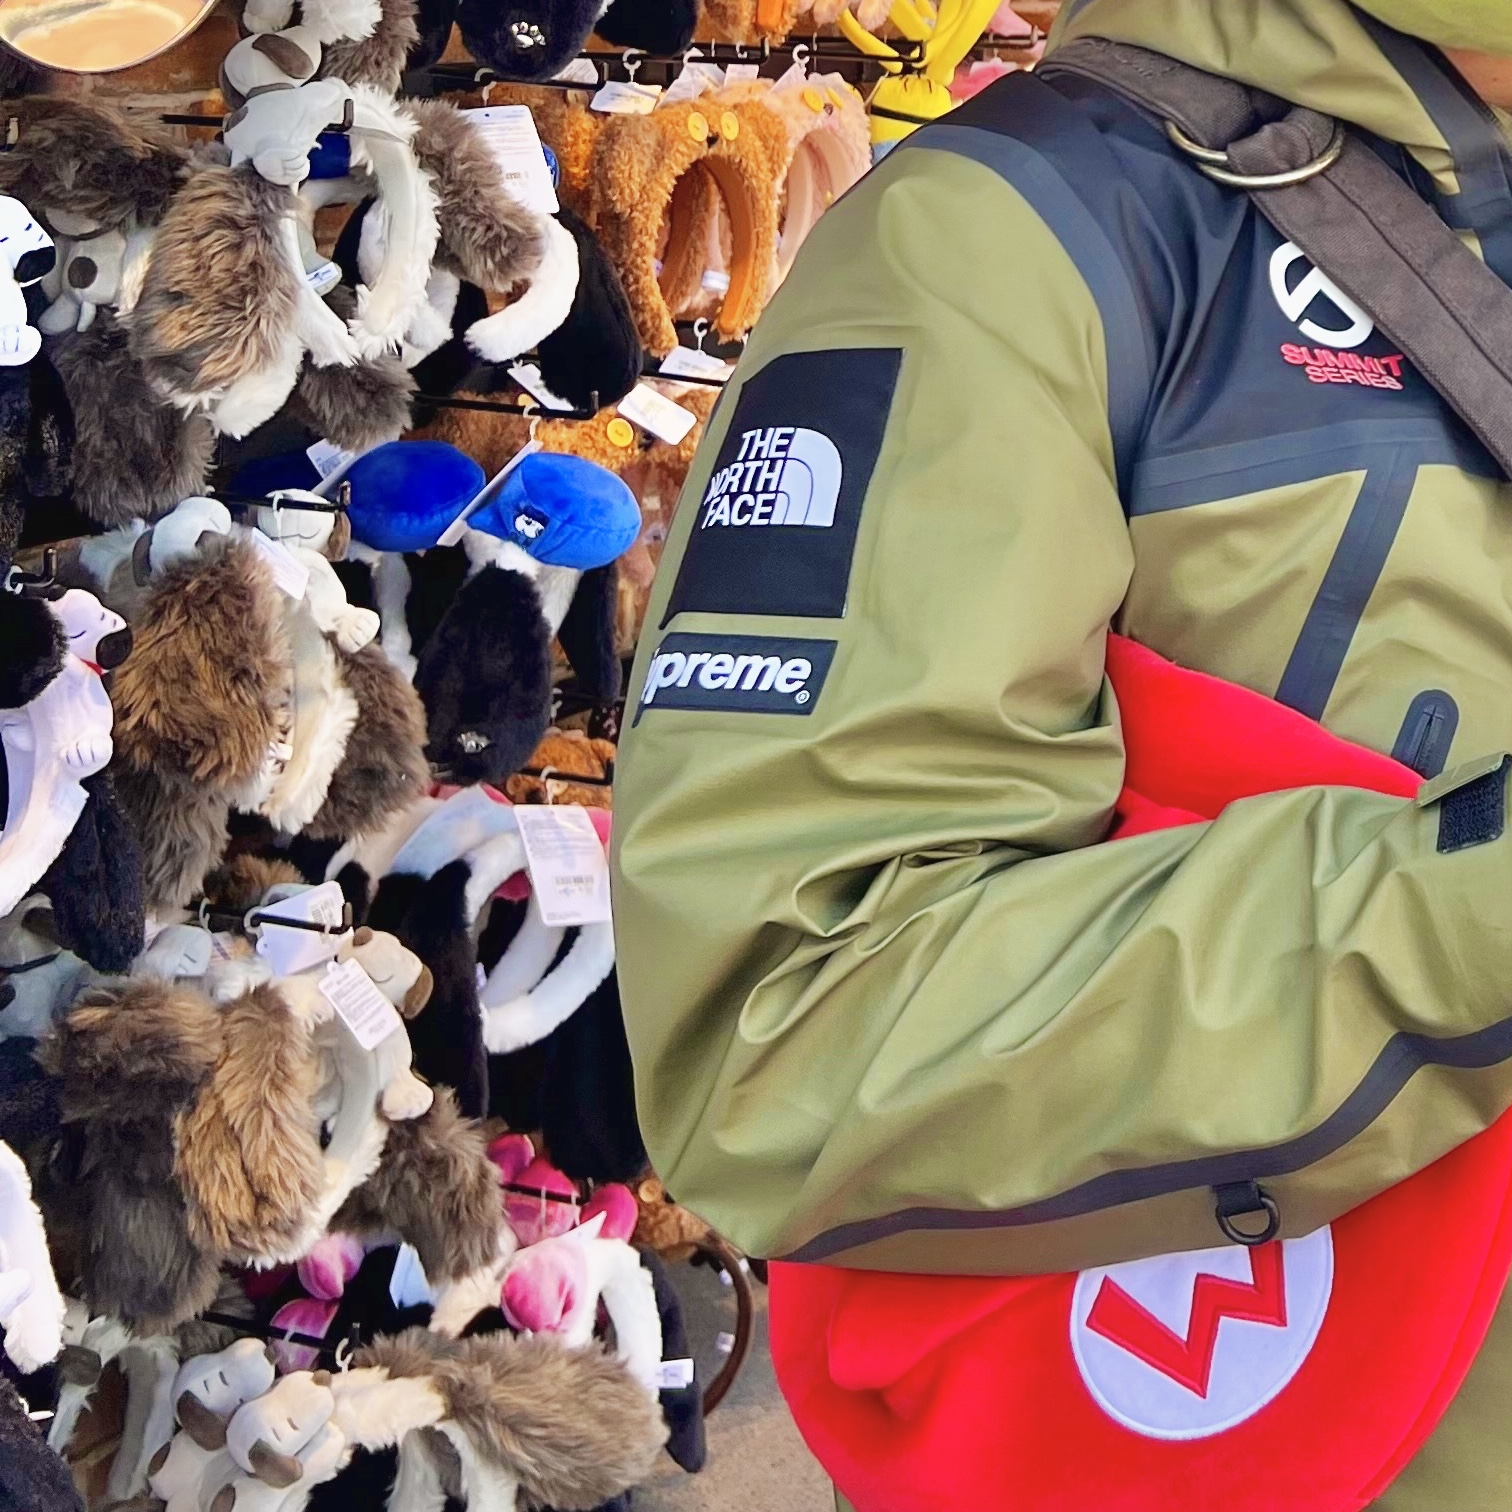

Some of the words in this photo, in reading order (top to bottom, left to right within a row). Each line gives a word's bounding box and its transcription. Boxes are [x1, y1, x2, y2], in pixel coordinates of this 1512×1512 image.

[1280, 343, 1404, 377] SUMMIT
[1305, 365, 1404, 390] SERIES
[737, 427, 796, 461] THE
[703, 459, 784, 506] NORTH
[701, 492, 777, 530] FACE
[640, 647, 812, 705] preme
